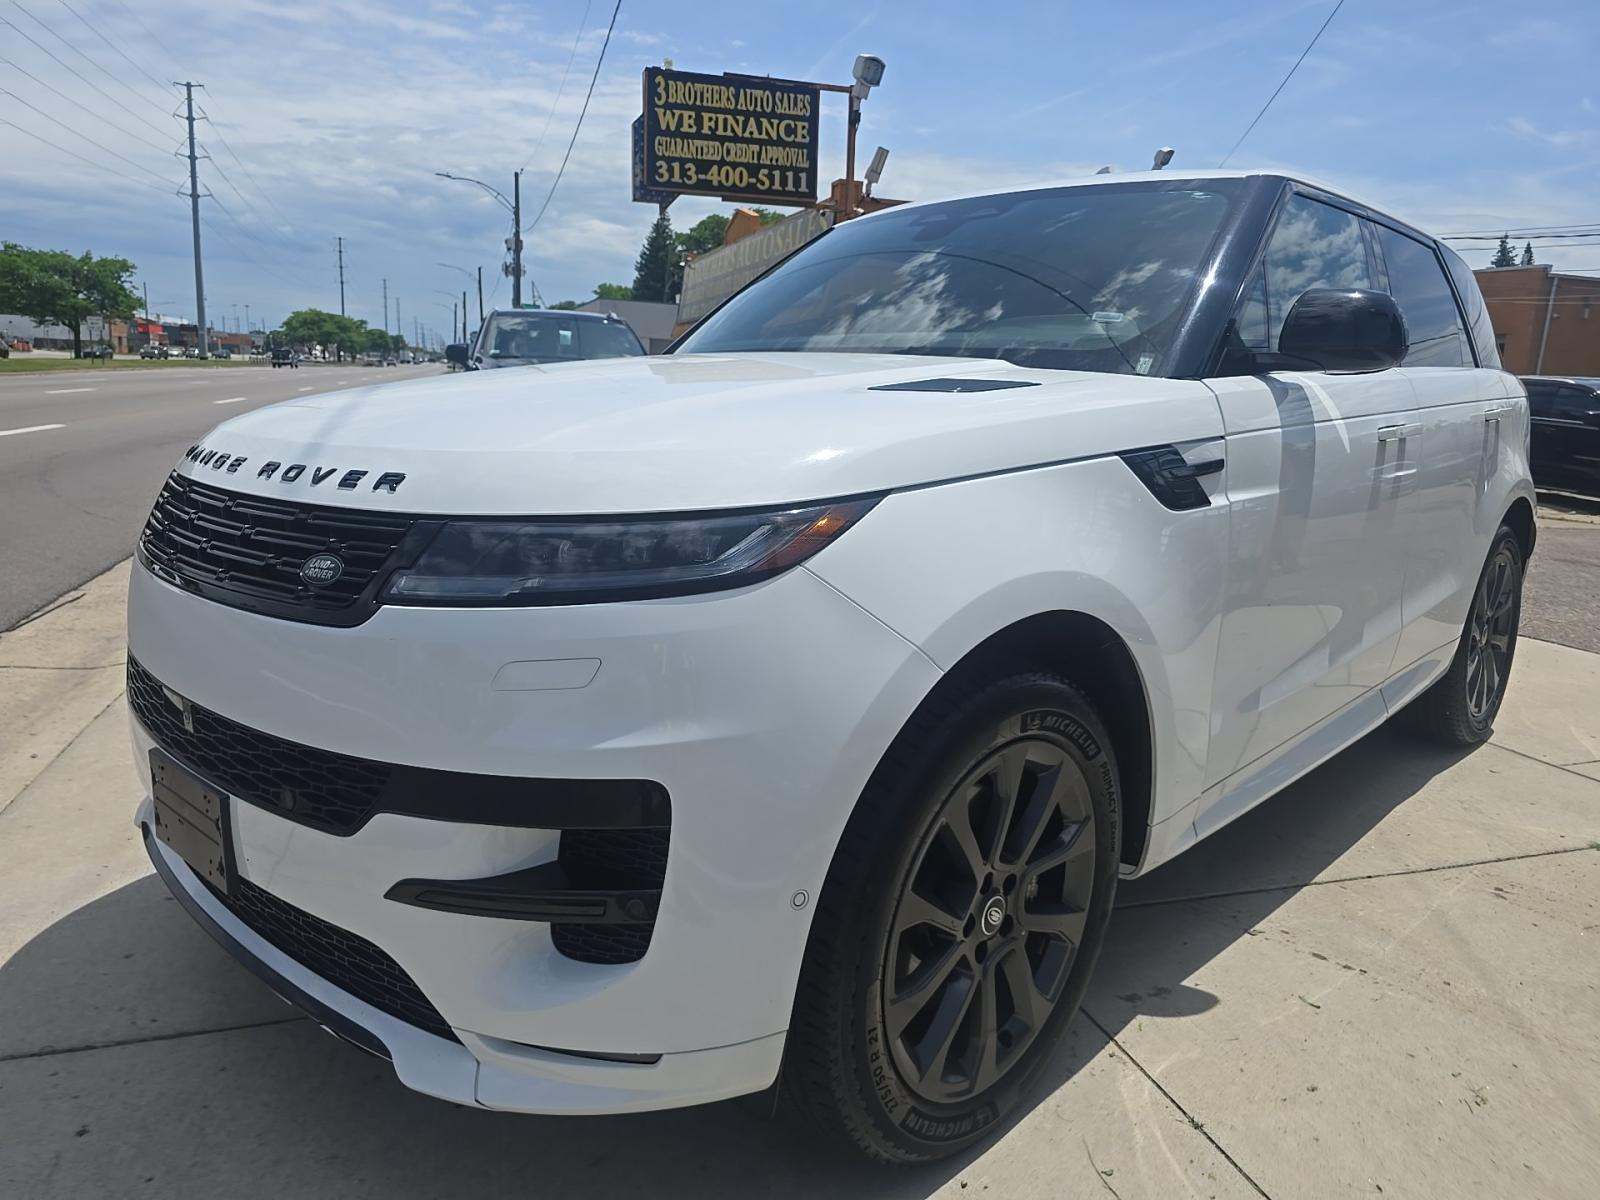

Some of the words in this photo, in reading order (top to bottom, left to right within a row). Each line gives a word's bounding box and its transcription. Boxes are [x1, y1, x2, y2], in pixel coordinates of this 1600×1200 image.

[654, 75, 667, 106] 3
[668, 80, 736, 110] BROTHERS
[737, 88, 773, 113] AUTO
[774, 91, 811, 117] SALES
[655, 107, 697, 134] WE
[701, 112, 810, 143] FINANCE
[654, 136, 722, 161] GUARANTEED
[723, 141, 760, 164] CREDIT
[760, 145, 809, 169] APPROVAL
[655, 160, 809, 192] 313-400-5111
[257, 461, 407, 495] ROVER
[307, 567, 333, 579] ROVER
[309, 558, 332, 569] LAND
[1042, 715, 1098, 757] MICHELIN
[1099, 761, 1118, 814] PRIMACY
[867, 1027, 879, 1046] 21
[870, 1049, 881, 1063] R
